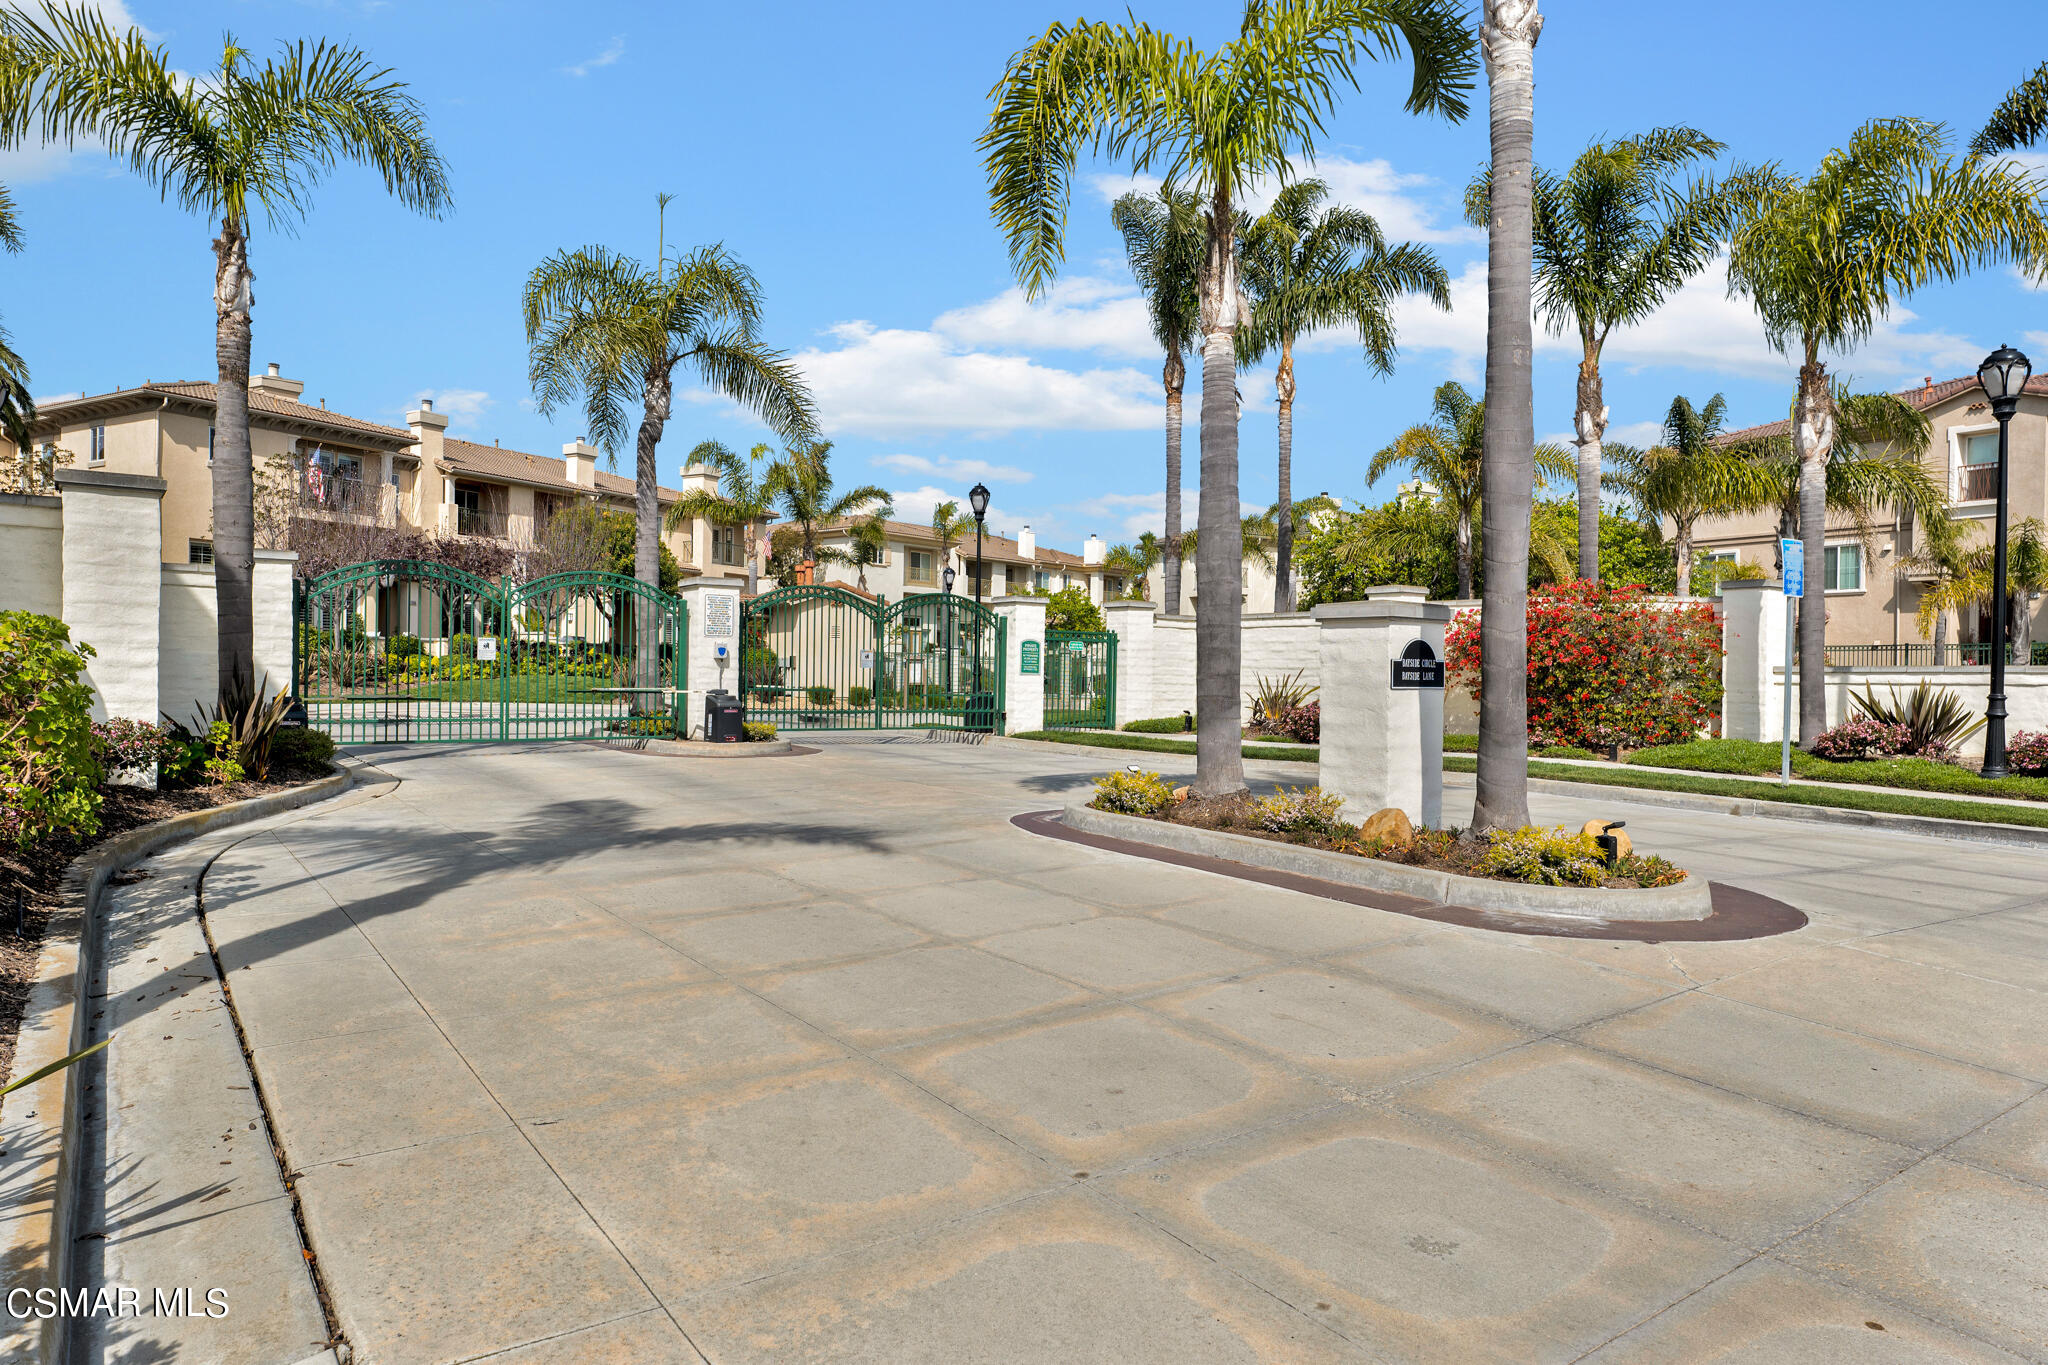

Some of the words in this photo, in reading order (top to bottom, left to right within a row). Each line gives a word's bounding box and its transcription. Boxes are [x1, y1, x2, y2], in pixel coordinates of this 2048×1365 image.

[1402, 658, 1420, 667] BAYSIDE
[1421, 659, 1436, 668] CIRCLE
[1401, 671, 1420, 680] BAYSIDE
[1422, 671, 1435, 680] LANE
